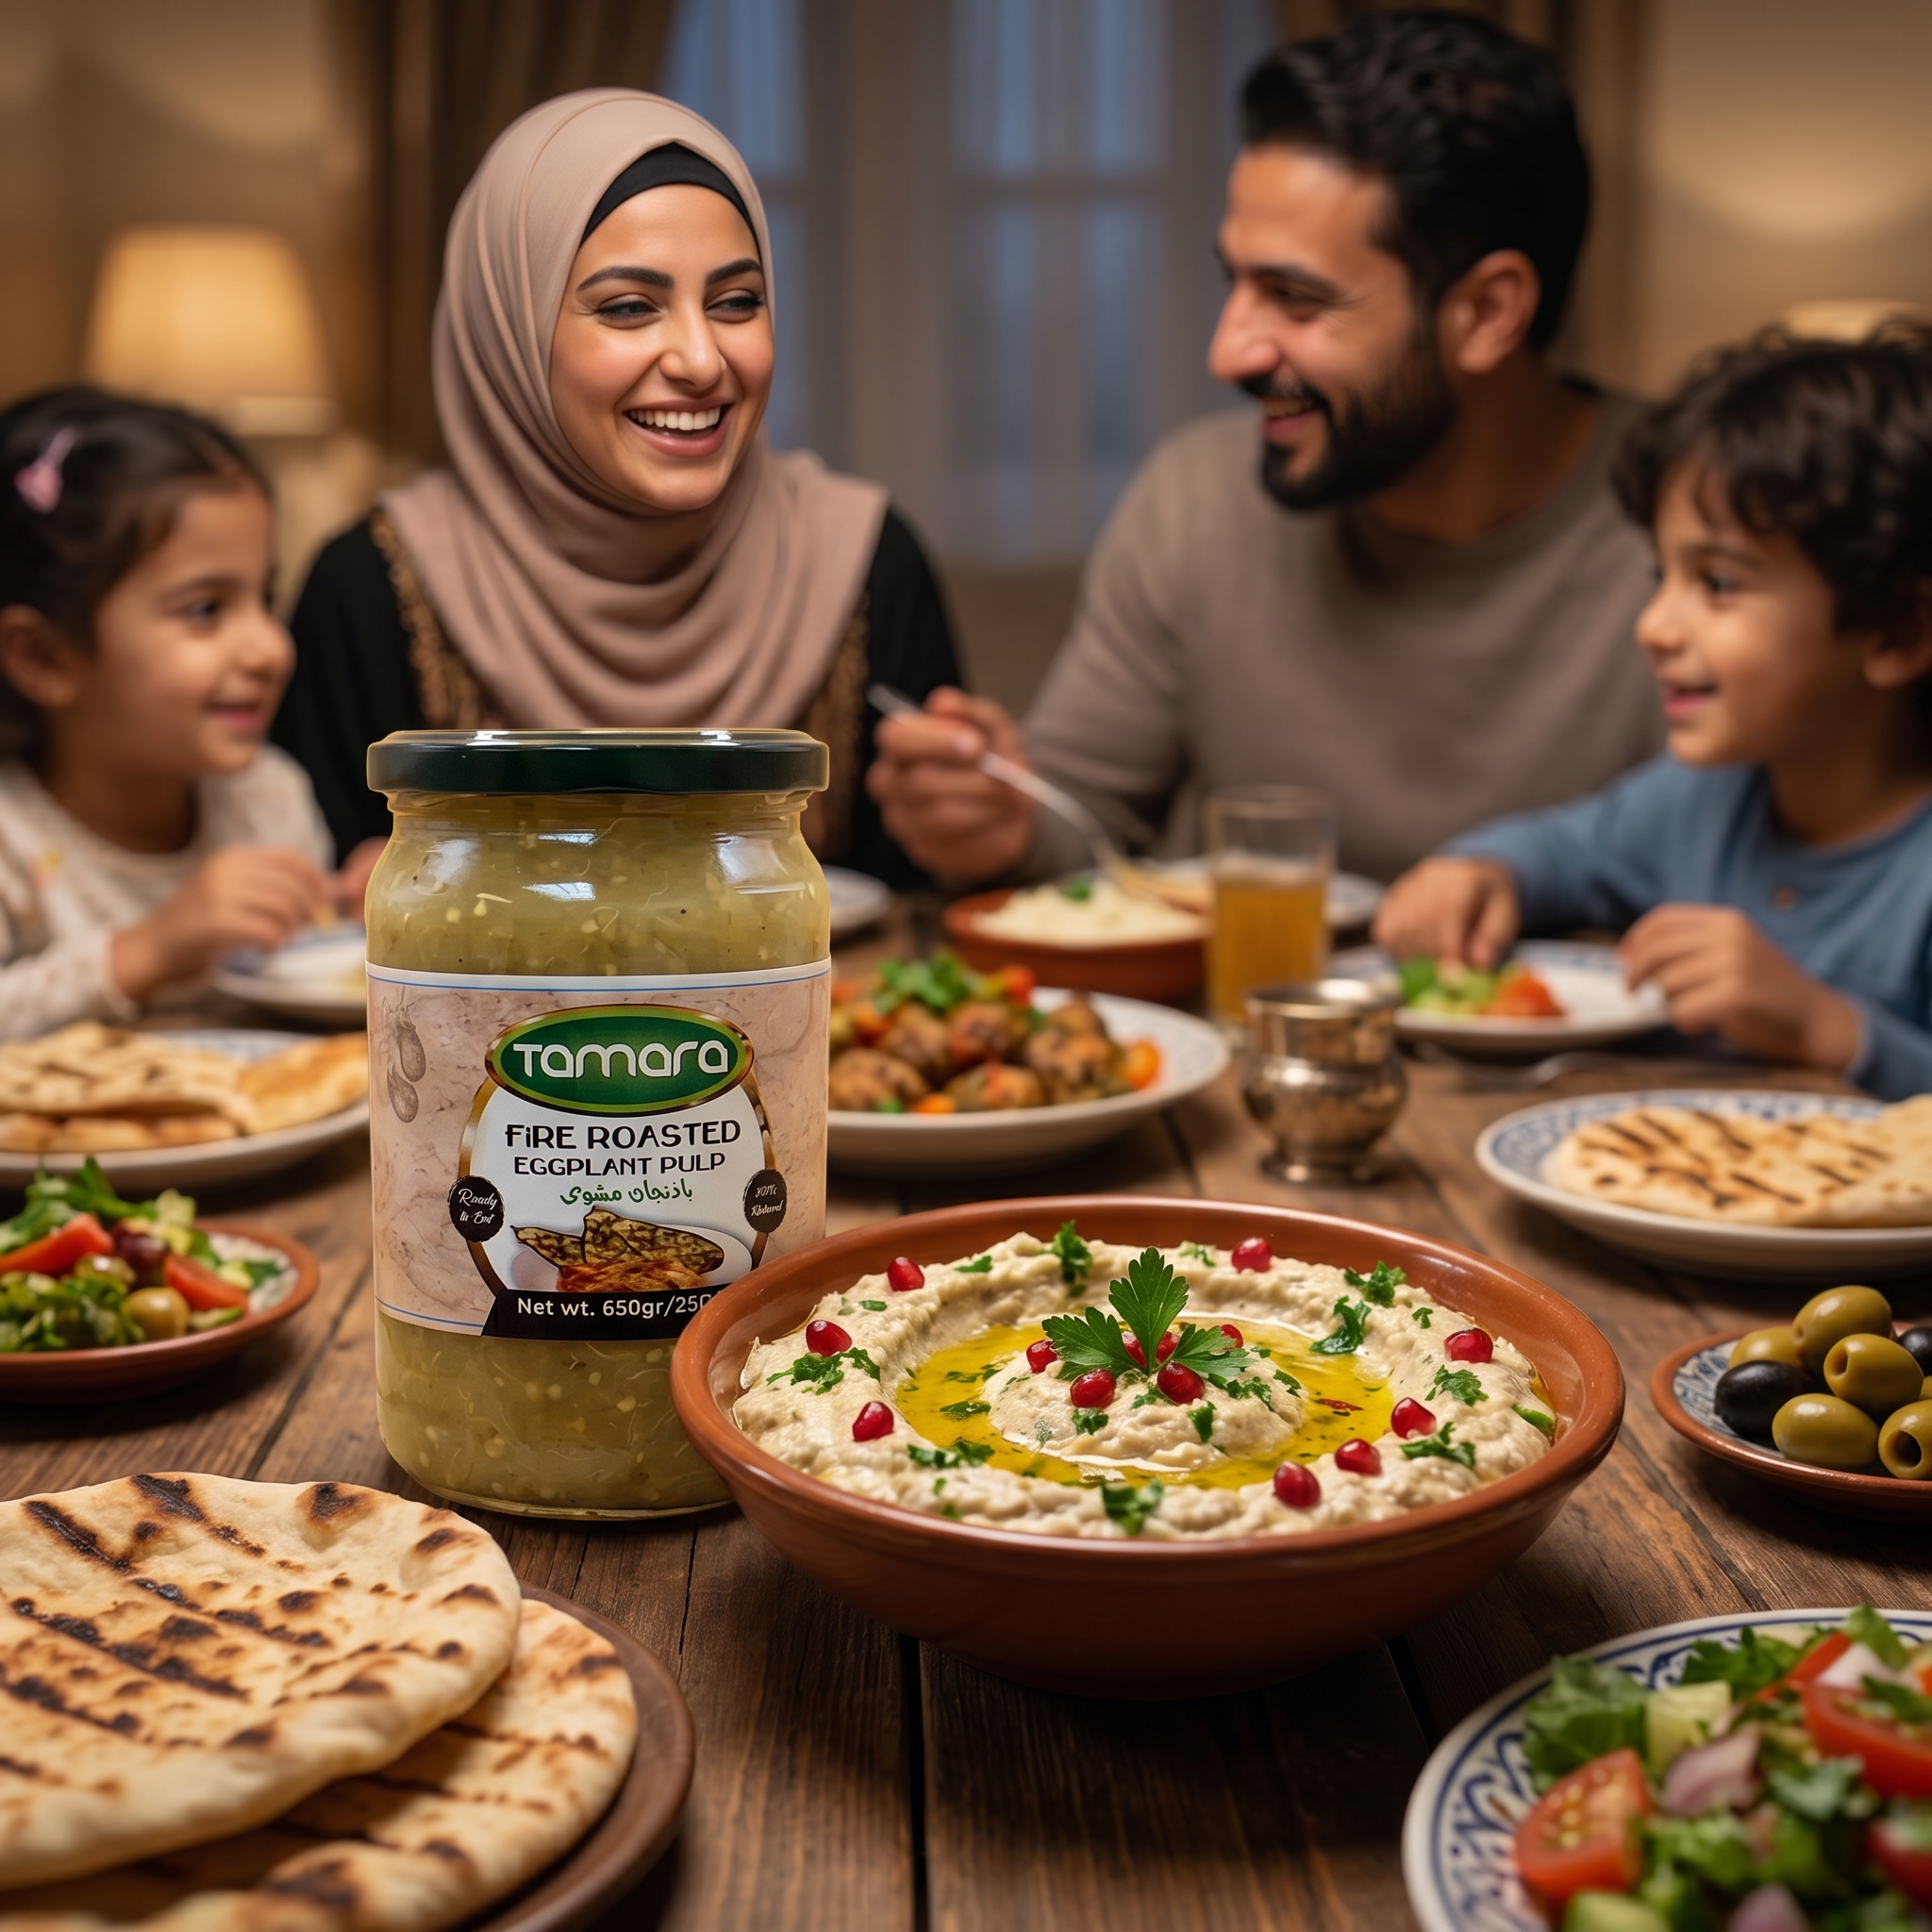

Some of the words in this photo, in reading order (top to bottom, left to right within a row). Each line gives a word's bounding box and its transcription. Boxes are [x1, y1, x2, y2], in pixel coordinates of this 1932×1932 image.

[587, 1120, 741, 1149] ROASTED
[514, 1156, 653, 1176] EGGPLANT
[660, 1152, 725, 1174] PULP
[518, 1298, 554, 1316] Net
[560, 1301, 595, 1316] wt.
